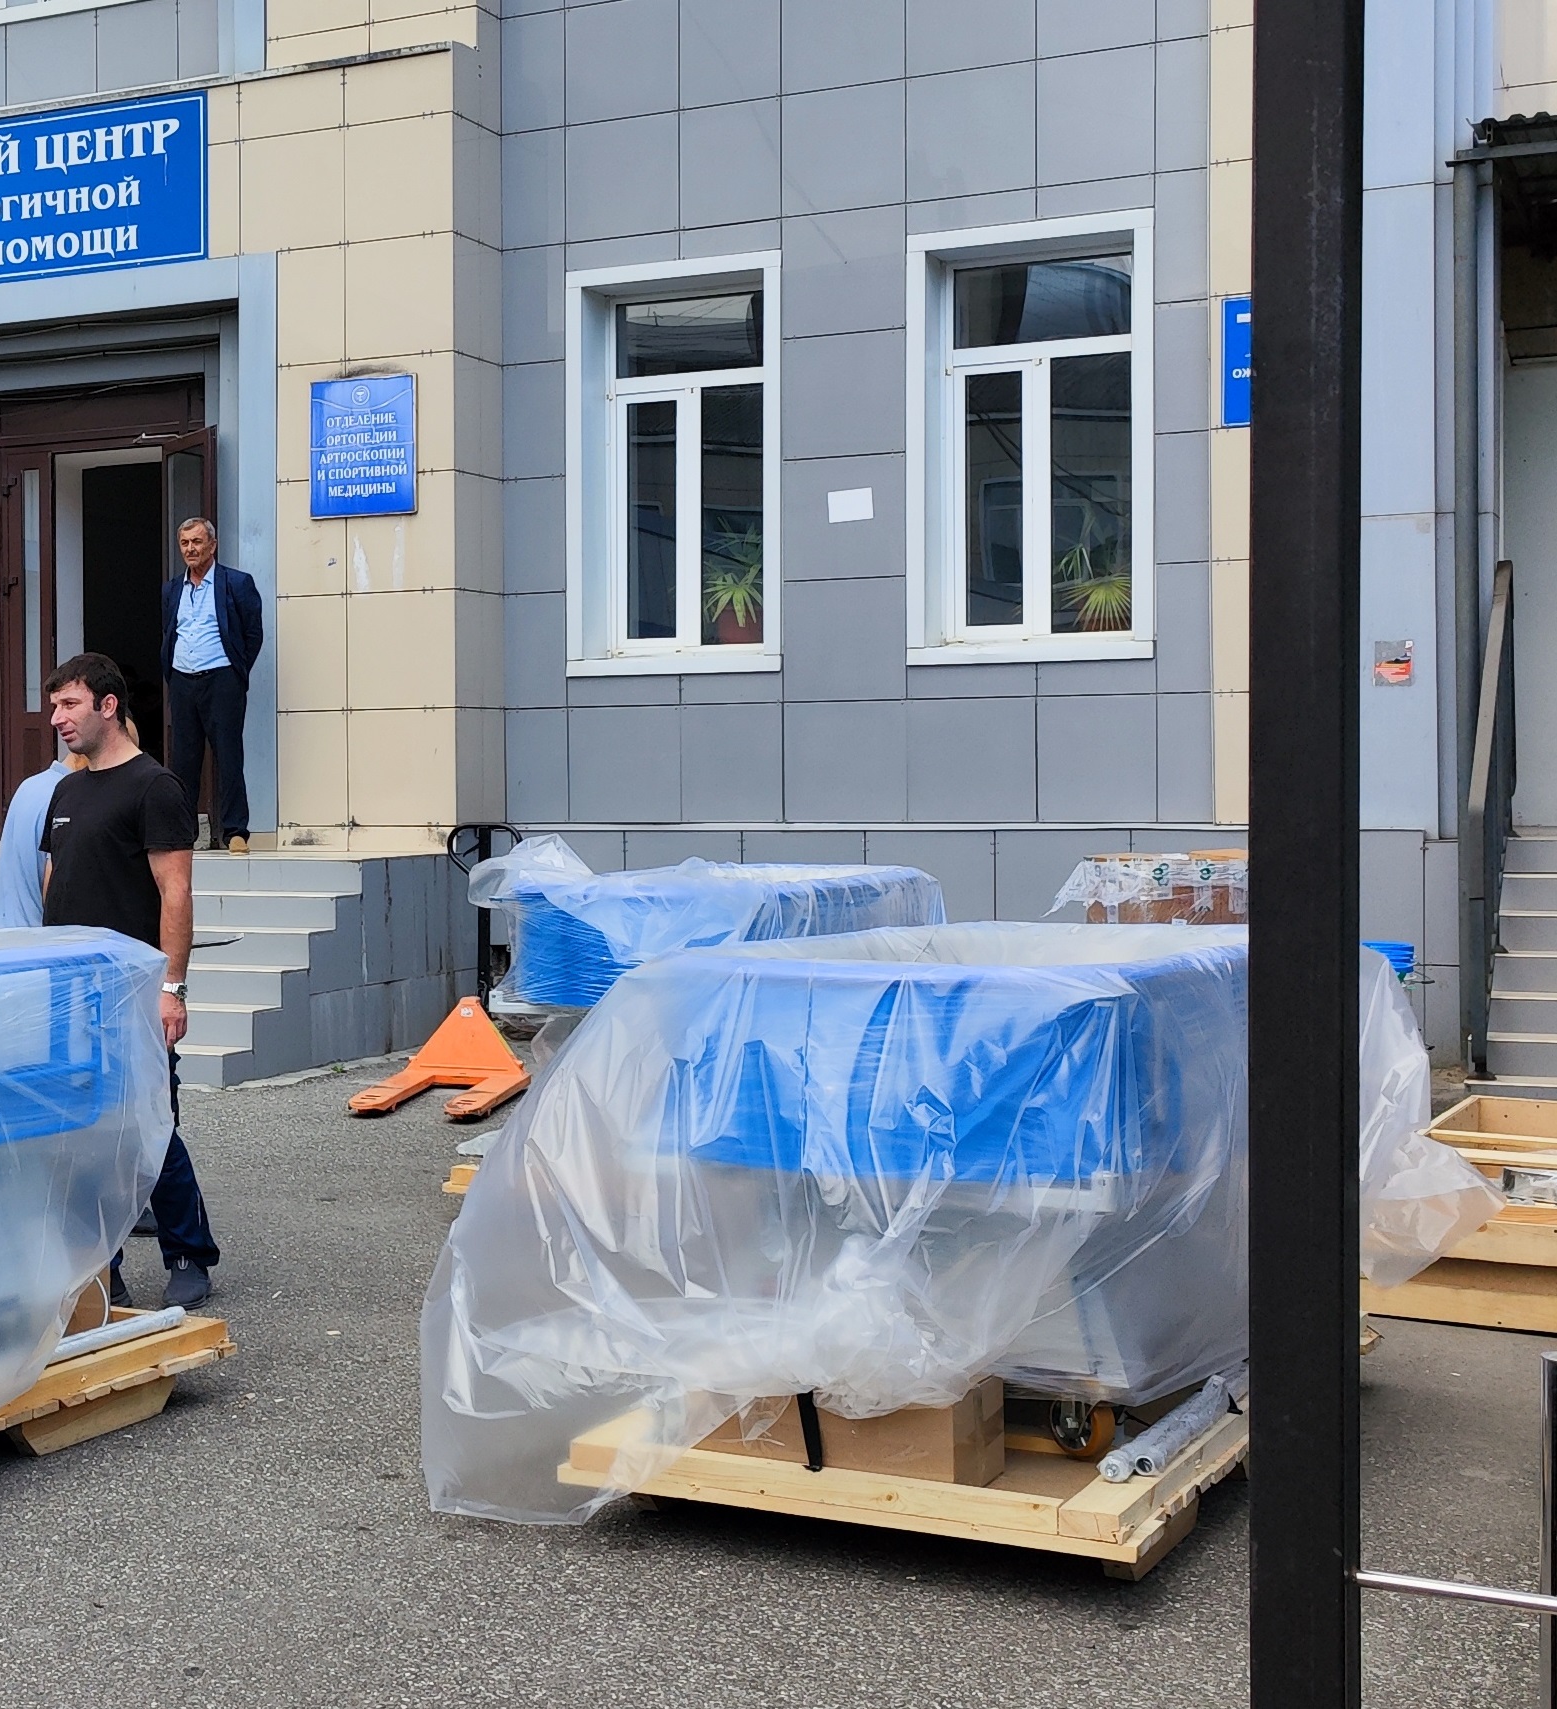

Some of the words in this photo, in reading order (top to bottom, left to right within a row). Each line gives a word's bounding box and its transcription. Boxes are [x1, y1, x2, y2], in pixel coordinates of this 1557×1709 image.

[34, 117, 181, 175] ЦЕНТР
[326, 412, 396, 428] ОТДЕЛЕНИЕ
[326, 430, 397, 446] ОРТОПЕДИИ
[319, 447, 405, 465] АРТРОСКОПИИ
[317, 470, 326, 481] И
[328, 462, 408, 480] СПОРТИВНОЙ
[328, 482, 396, 498] МЕДИЦИНЫ
